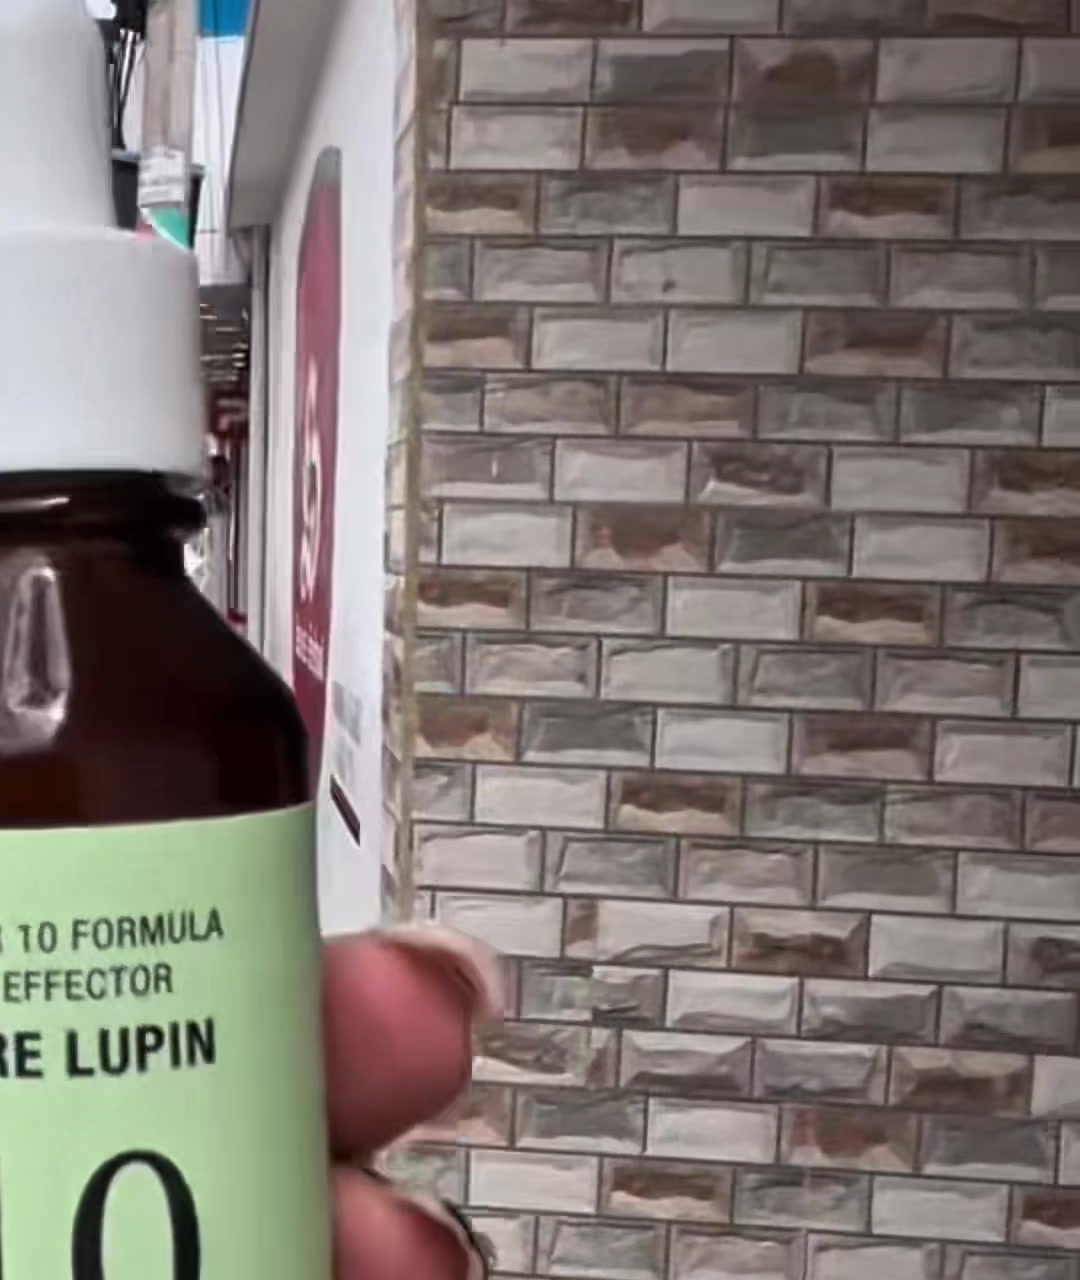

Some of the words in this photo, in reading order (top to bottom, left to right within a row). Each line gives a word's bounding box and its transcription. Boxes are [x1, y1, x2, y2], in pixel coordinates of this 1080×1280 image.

[18, 921, 59, 954] 10
[71, 906, 225, 952] FORMULA
[3, 962, 174, 1004] EFFECTOR
[65, 1016, 217, 1079] LUPIN
